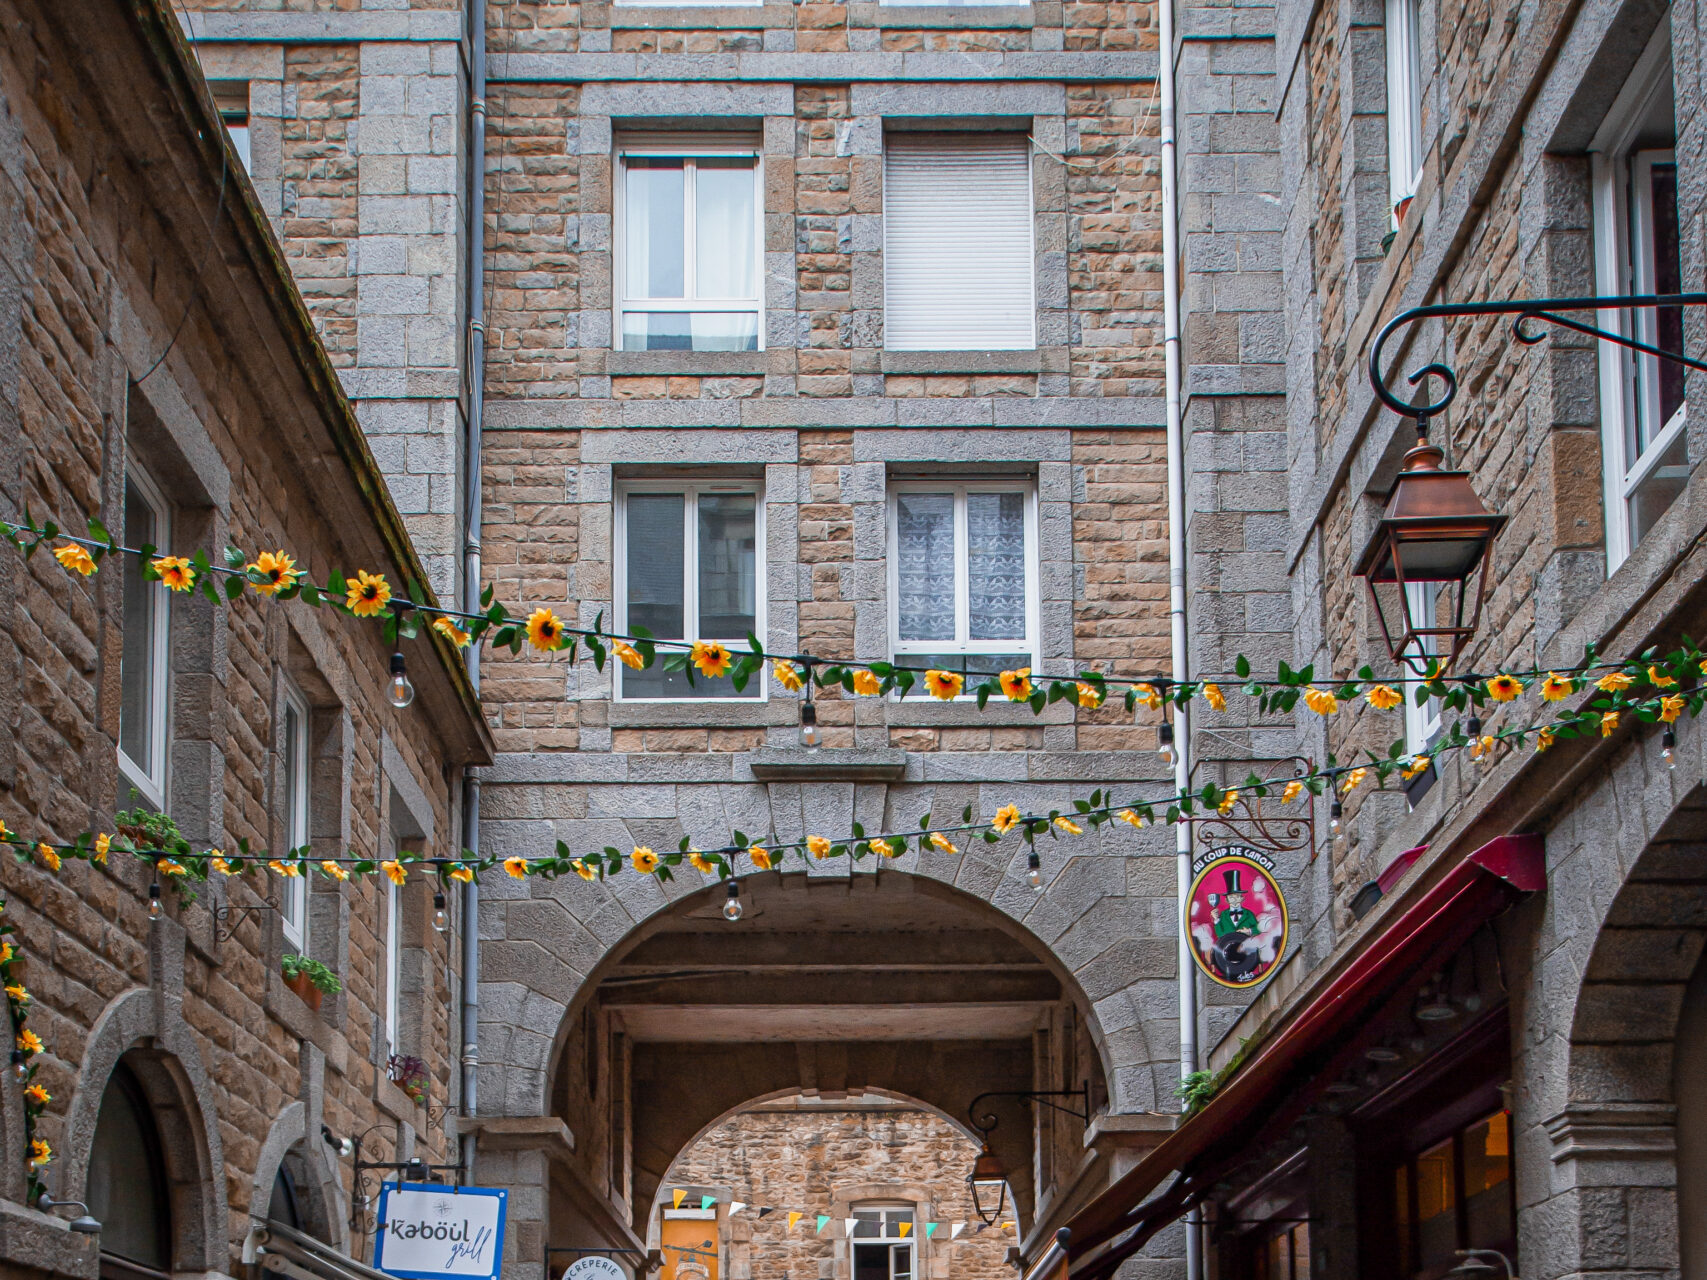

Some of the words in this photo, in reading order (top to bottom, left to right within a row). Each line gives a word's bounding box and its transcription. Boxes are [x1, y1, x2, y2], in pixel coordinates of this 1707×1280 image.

[1193, 860, 1205, 873] AU
[1203, 848, 1228, 863] COUP
[1229, 847, 1243, 856] DE
[1244, 849, 1275, 870] CANON
[445, 1225, 493, 1269] grill
